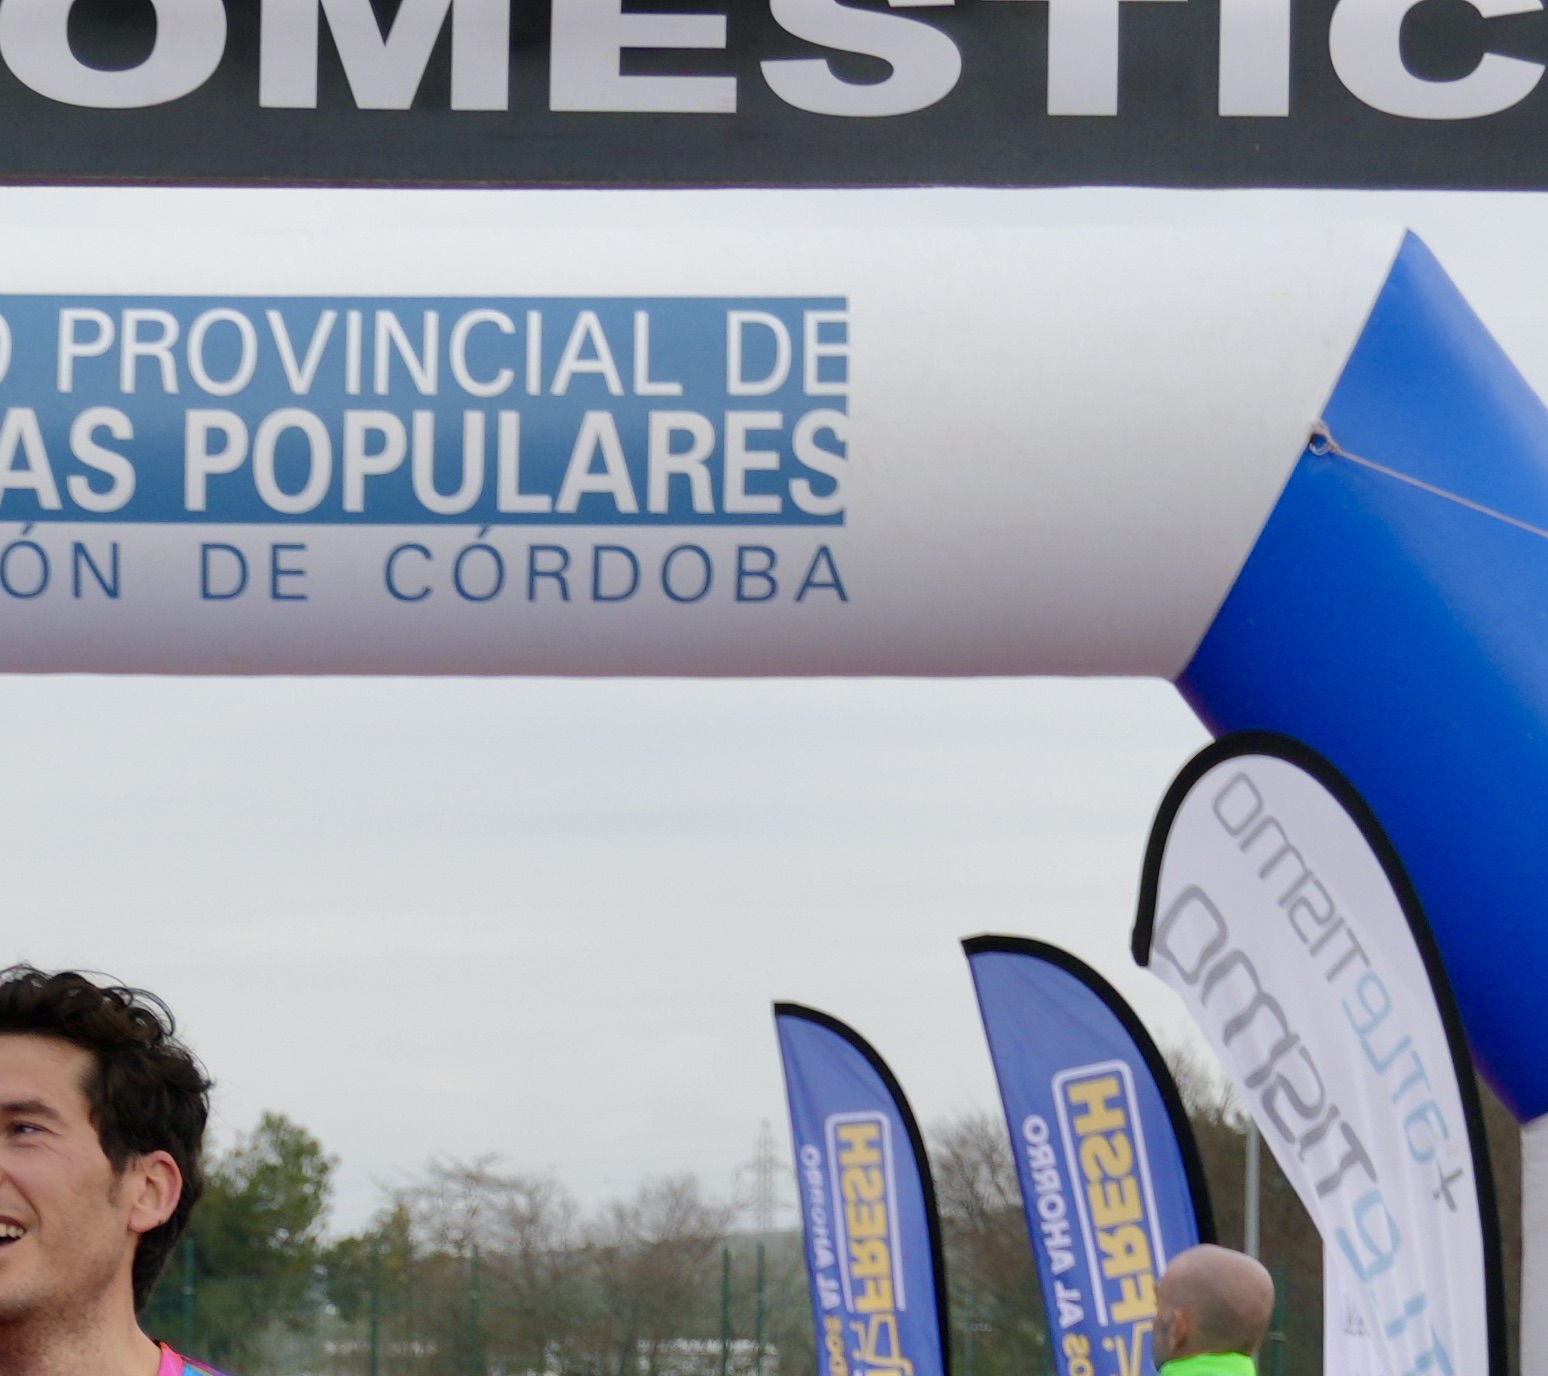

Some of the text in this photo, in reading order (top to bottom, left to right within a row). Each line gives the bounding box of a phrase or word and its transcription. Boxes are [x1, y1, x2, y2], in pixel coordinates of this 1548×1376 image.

[57, 306, 684, 397] PROVINCIAL
[726, 310, 850, 396] DE
[184, 407, 849, 516] POPULARES
[200, 543, 308, 601] DE
[385, 525, 850, 602] CÓRDOBA
